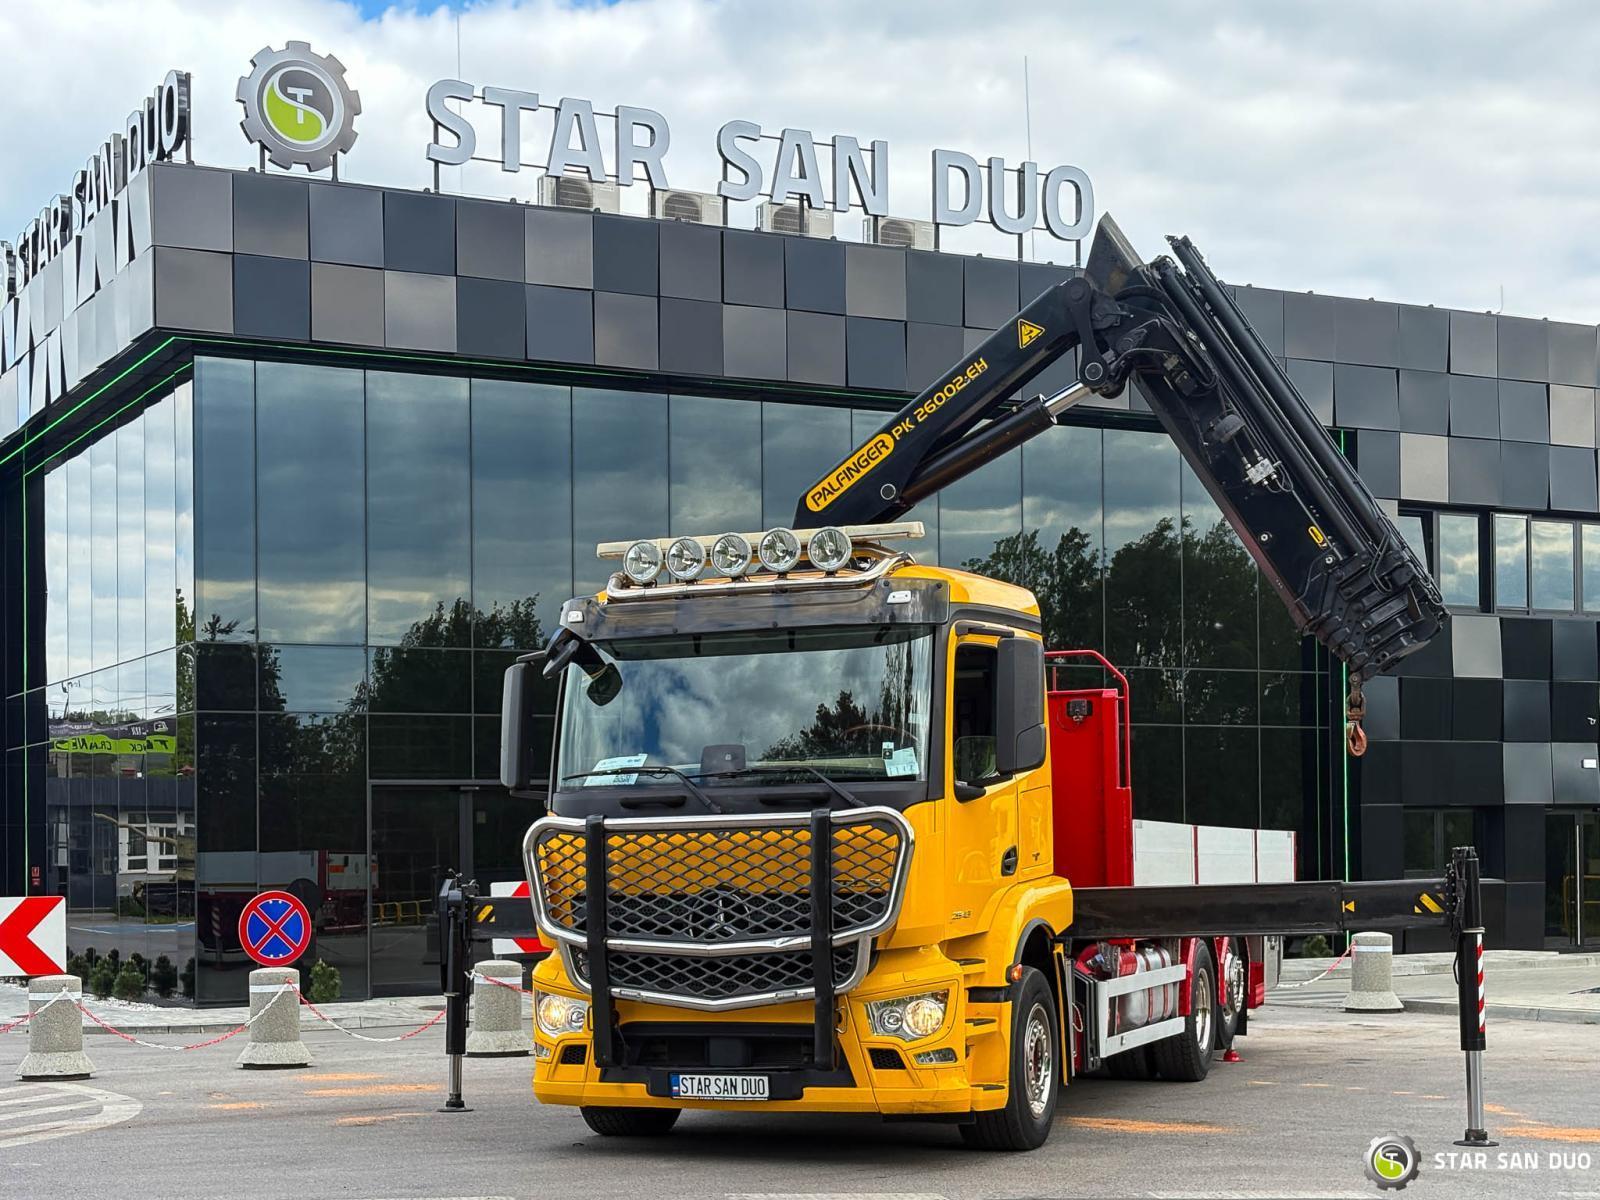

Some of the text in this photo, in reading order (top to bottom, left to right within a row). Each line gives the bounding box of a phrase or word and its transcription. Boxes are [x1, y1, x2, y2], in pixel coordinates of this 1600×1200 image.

[16, 69, 186, 294] STAR SAN DUO
[426, 79, 1094, 241] STAR SAN DUO
[811, 438, 890, 508] PALFINGER
[891, 417, 916, 440] PK
[680, 1077, 766, 1095] STAR SAN DUO
